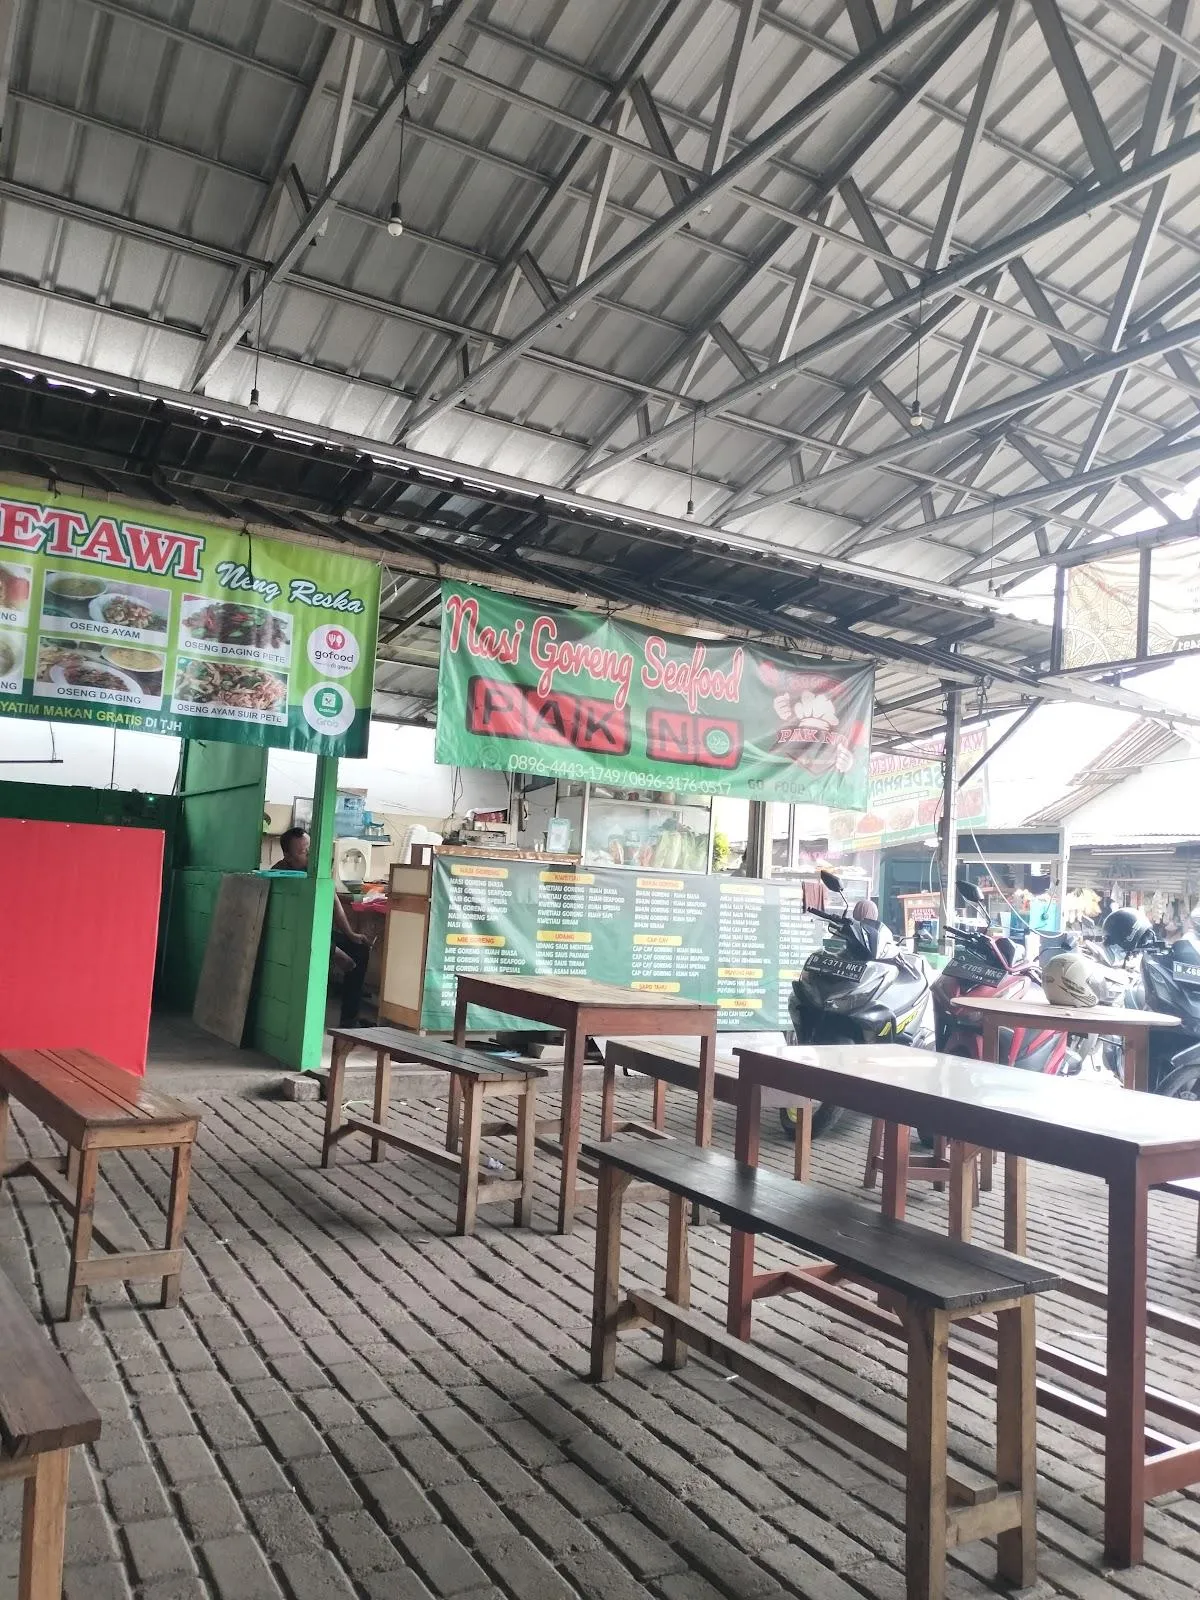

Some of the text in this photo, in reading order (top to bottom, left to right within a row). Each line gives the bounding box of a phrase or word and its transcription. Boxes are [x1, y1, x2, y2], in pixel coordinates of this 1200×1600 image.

[216, 561, 366, 615] Neng Reska
[70, 622, 141, 639] OSENG AYAM
[185, 641, 218, 652] OSENG
[222, 647, 260, 658] DAGING
[315, 650, 354, 663] gofood
[447, 594, 744, 713] Nasi Goreng Seafood
[57, 688, 141, 704] OSENG DAGING
[44, 706, 92, 719] MAKAN
[97, 711, 143, 726] GRATIS
[146, 718, 158, 727] DI
[178, 704, 209, 714] OSENG
[211, 707, 235, 716] AYAM
[238, 711, 258, 719] SUIR
[483, 687, 734, 757] PAK NO
[778, 729, 820, 744] PAK
